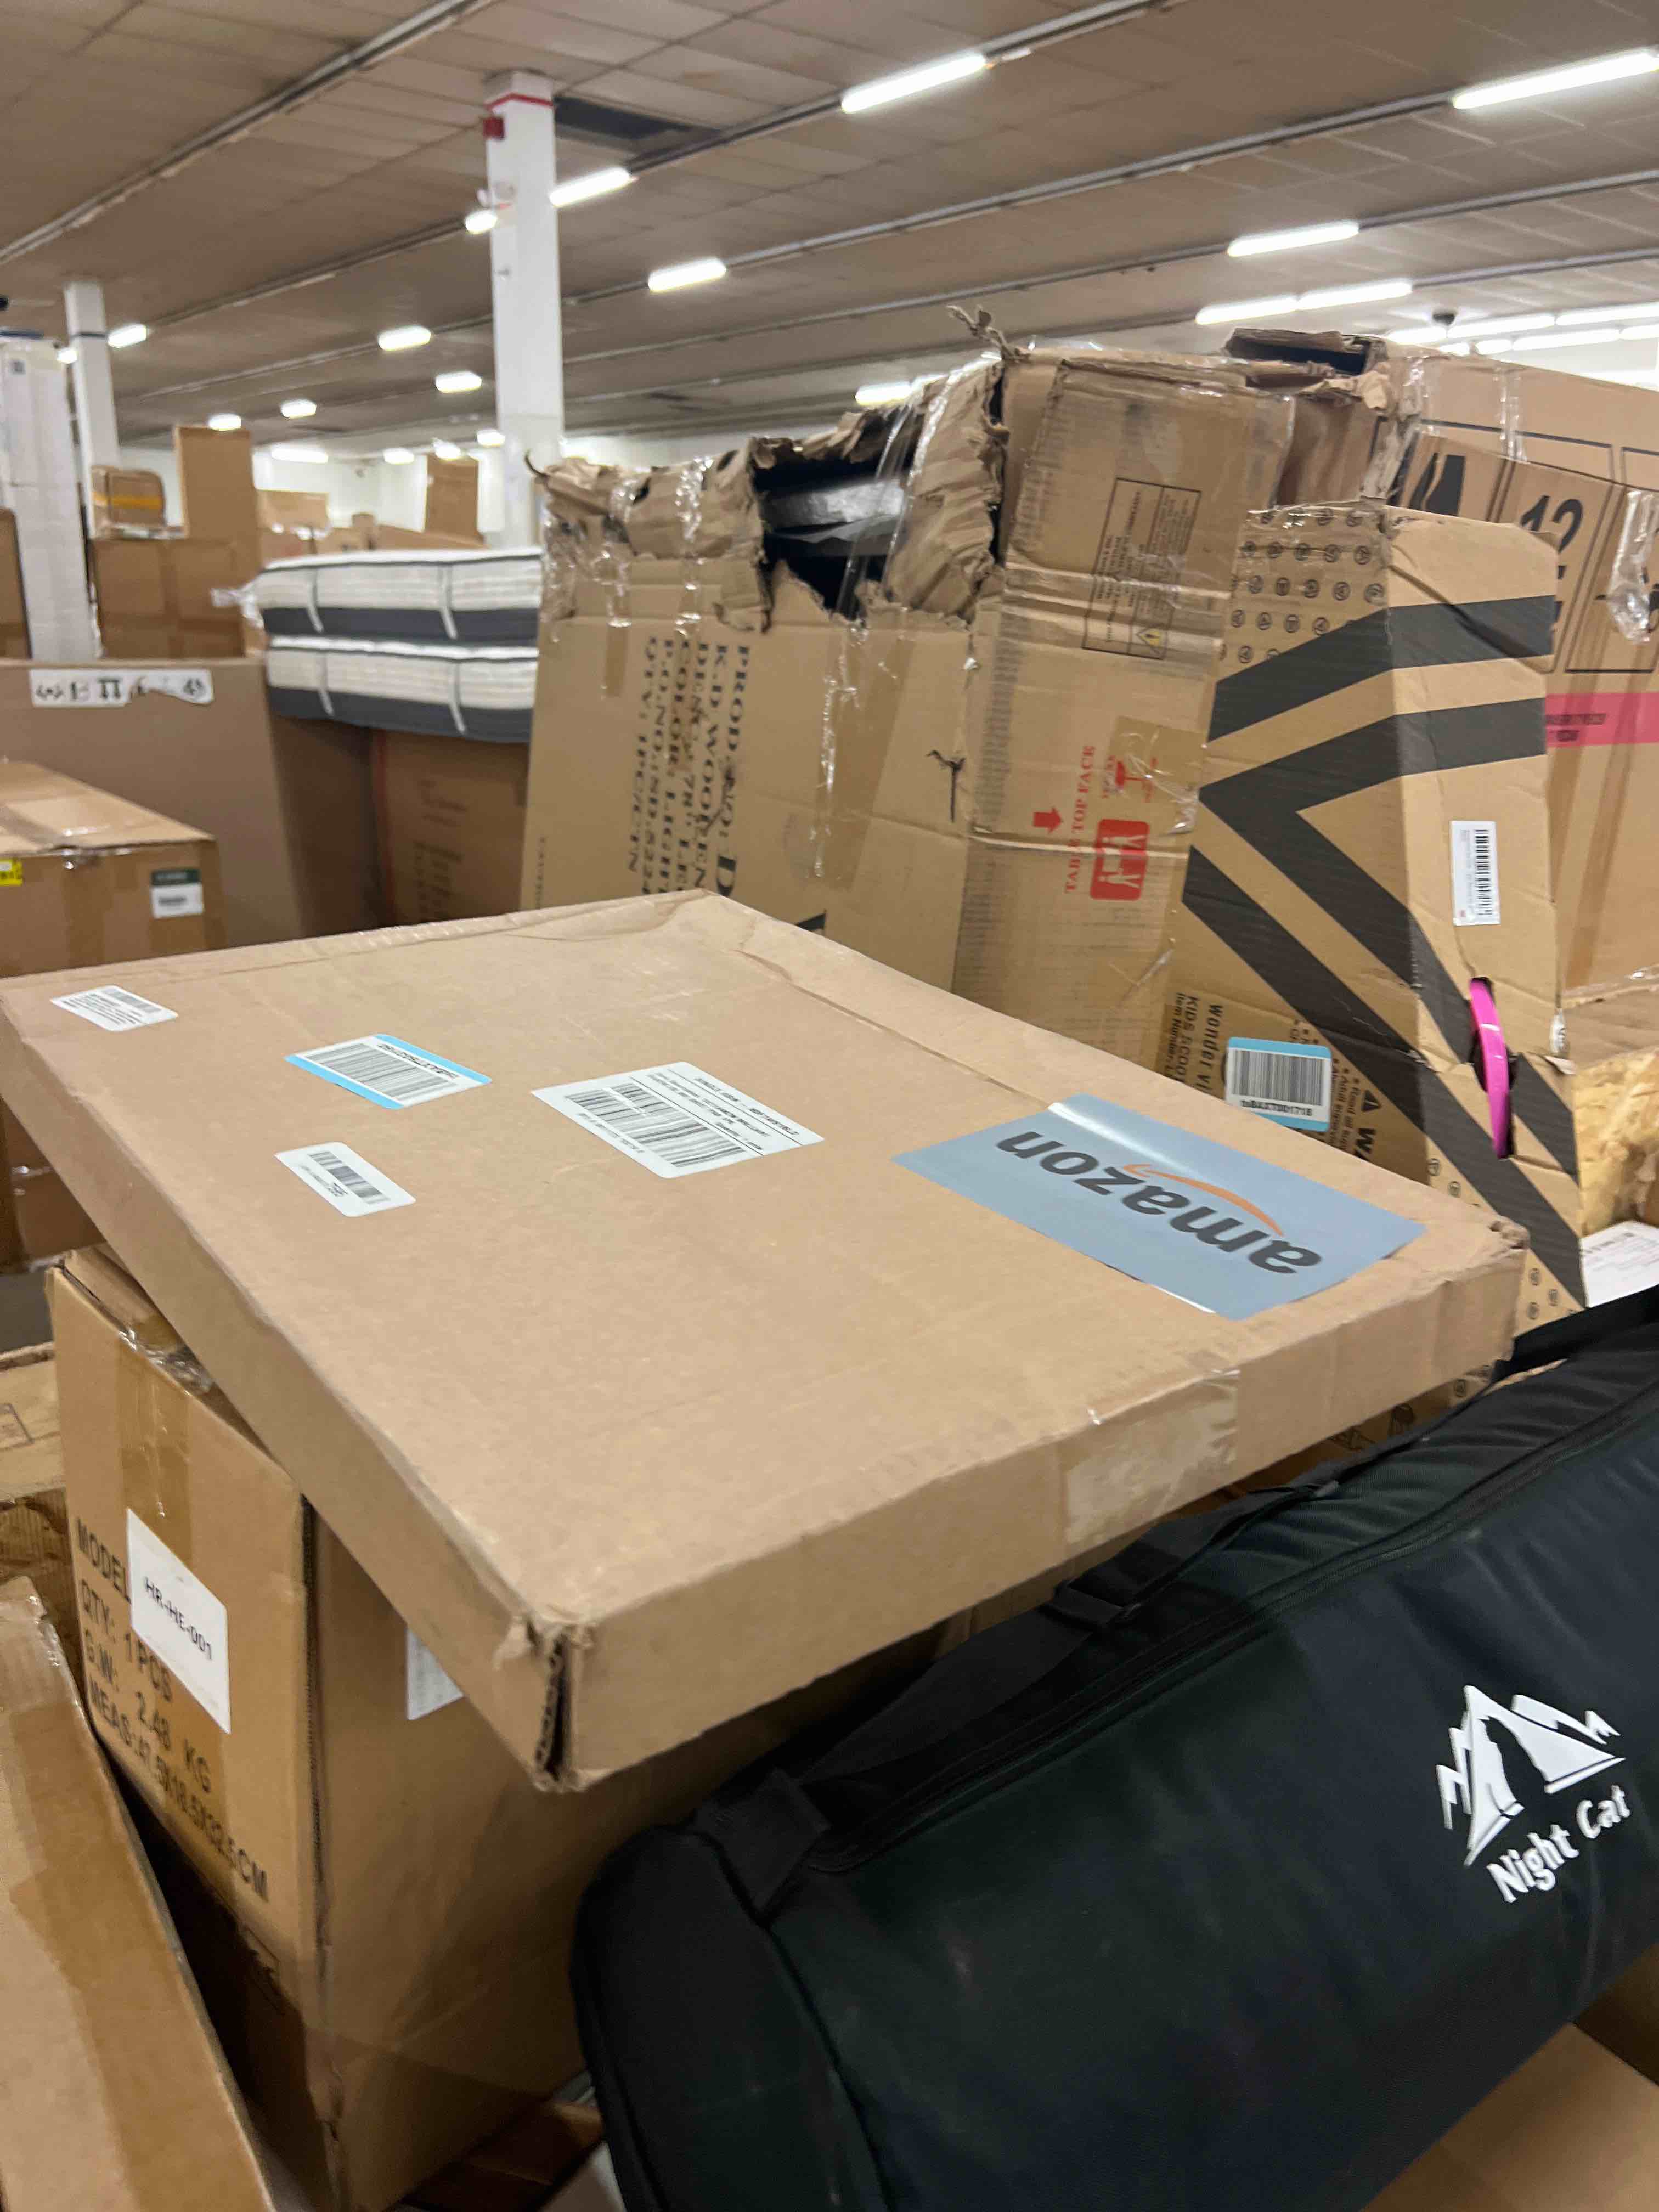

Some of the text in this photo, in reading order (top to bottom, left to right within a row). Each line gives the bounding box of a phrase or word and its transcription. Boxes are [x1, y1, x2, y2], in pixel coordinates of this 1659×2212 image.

[1065, 839, 1081, 895] TABE
[1183, 996, 1200, 1032] KIDS
[1199, 1004, 1223, 1068] wonder
[995, 1130, 1323, 1275] amazon
[78, 1516, 132, 1605] MODEL
[144, 1575, 213, 1661] HR-HE-001
[184, 1737, 212, 1794] KG
[1486, 1784, 1631, 1903] Night Cat
